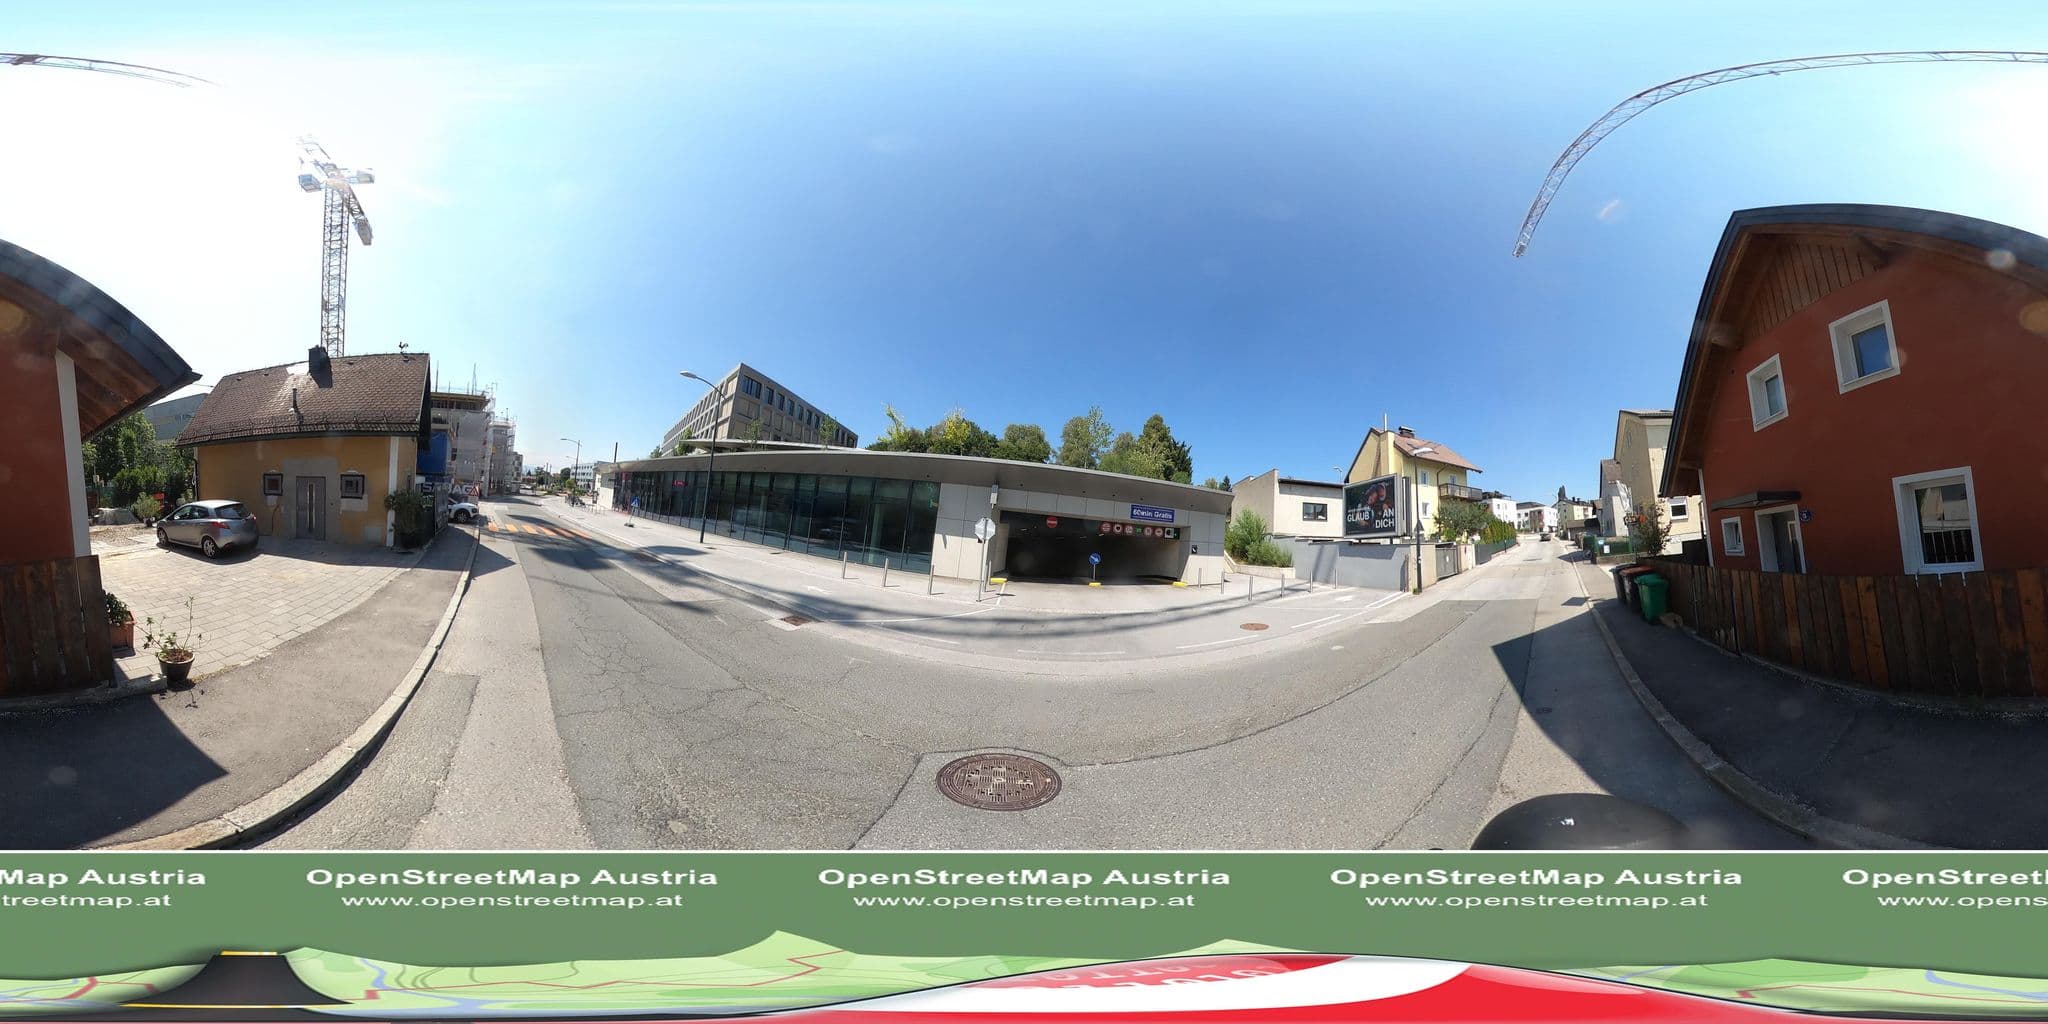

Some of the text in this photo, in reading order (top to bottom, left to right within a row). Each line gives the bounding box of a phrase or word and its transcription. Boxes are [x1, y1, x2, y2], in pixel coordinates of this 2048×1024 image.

[1347, 511, 1370, 523] GLAUB
[1382, 508, 1395, 518] AN
[1375, 517, 1395, 528] DICH
